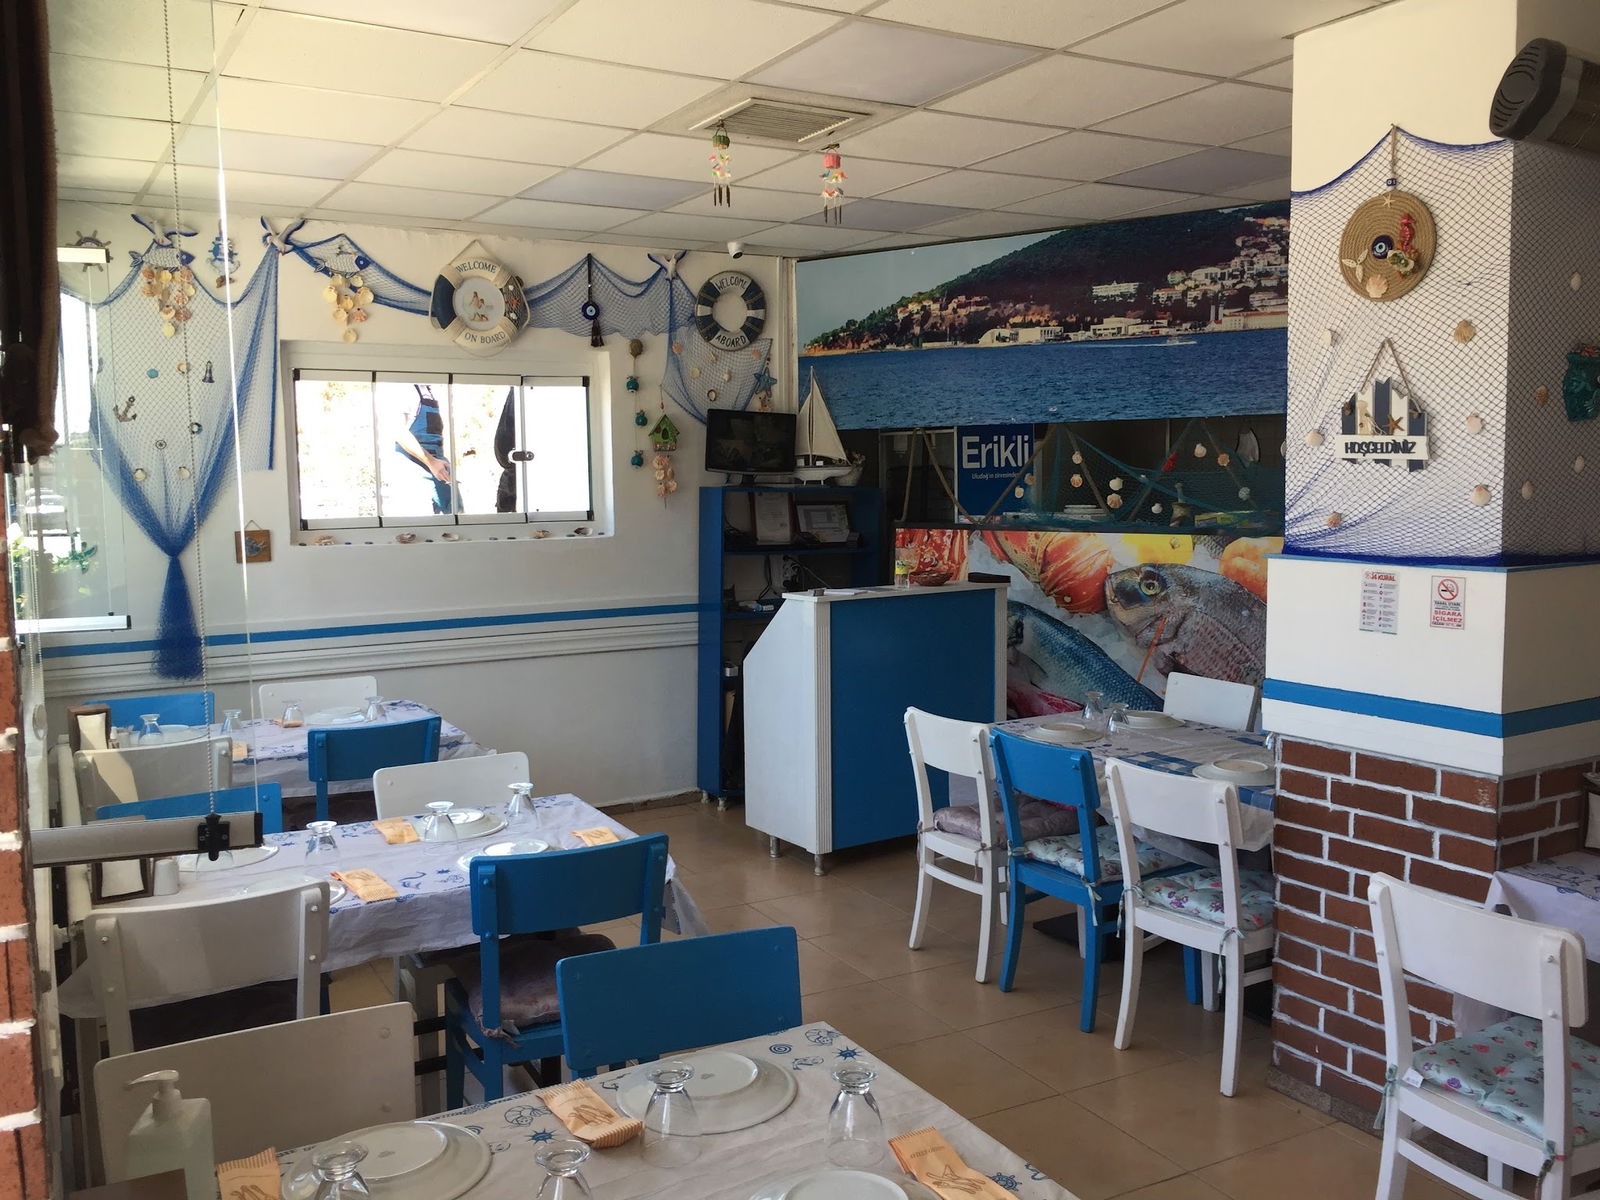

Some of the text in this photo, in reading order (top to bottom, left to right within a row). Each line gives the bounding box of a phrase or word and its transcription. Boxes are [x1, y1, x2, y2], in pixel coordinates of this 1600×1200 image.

[456, 261, 497, 274] WELCOME
[715, 276, 747, 290] WELCOME
[464, 331, 506, 344] ON BOARD
[715, 334, 747, 348] ABOARD
[962, 434, 1029, 470] Erikli
[1344, 439, 1417, 457] HOŞGELDİNİZ
